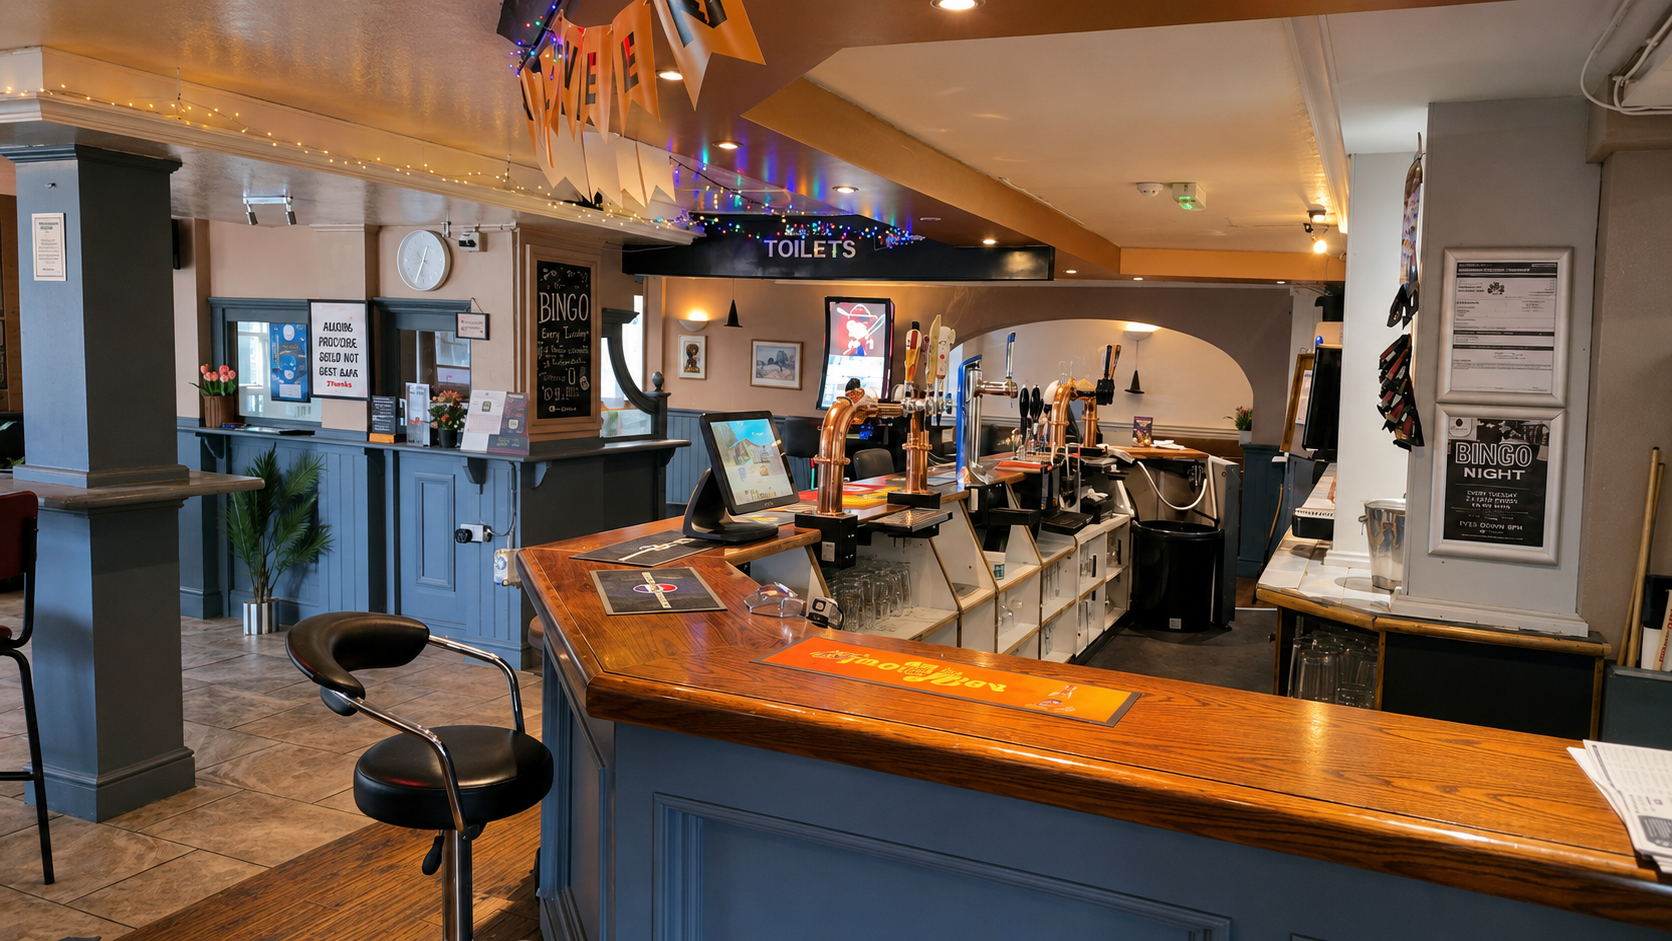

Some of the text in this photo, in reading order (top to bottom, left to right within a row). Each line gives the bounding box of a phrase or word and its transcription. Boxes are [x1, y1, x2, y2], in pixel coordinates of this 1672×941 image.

[763, 239, 857, 259] TOILETS
[538, 291, 590, 325] BINGO
[343, 352, 360, 363] NOT
[1455, 442, 1533, 468] BINGO
[1463, 467, 1526, 480] NIGHT
